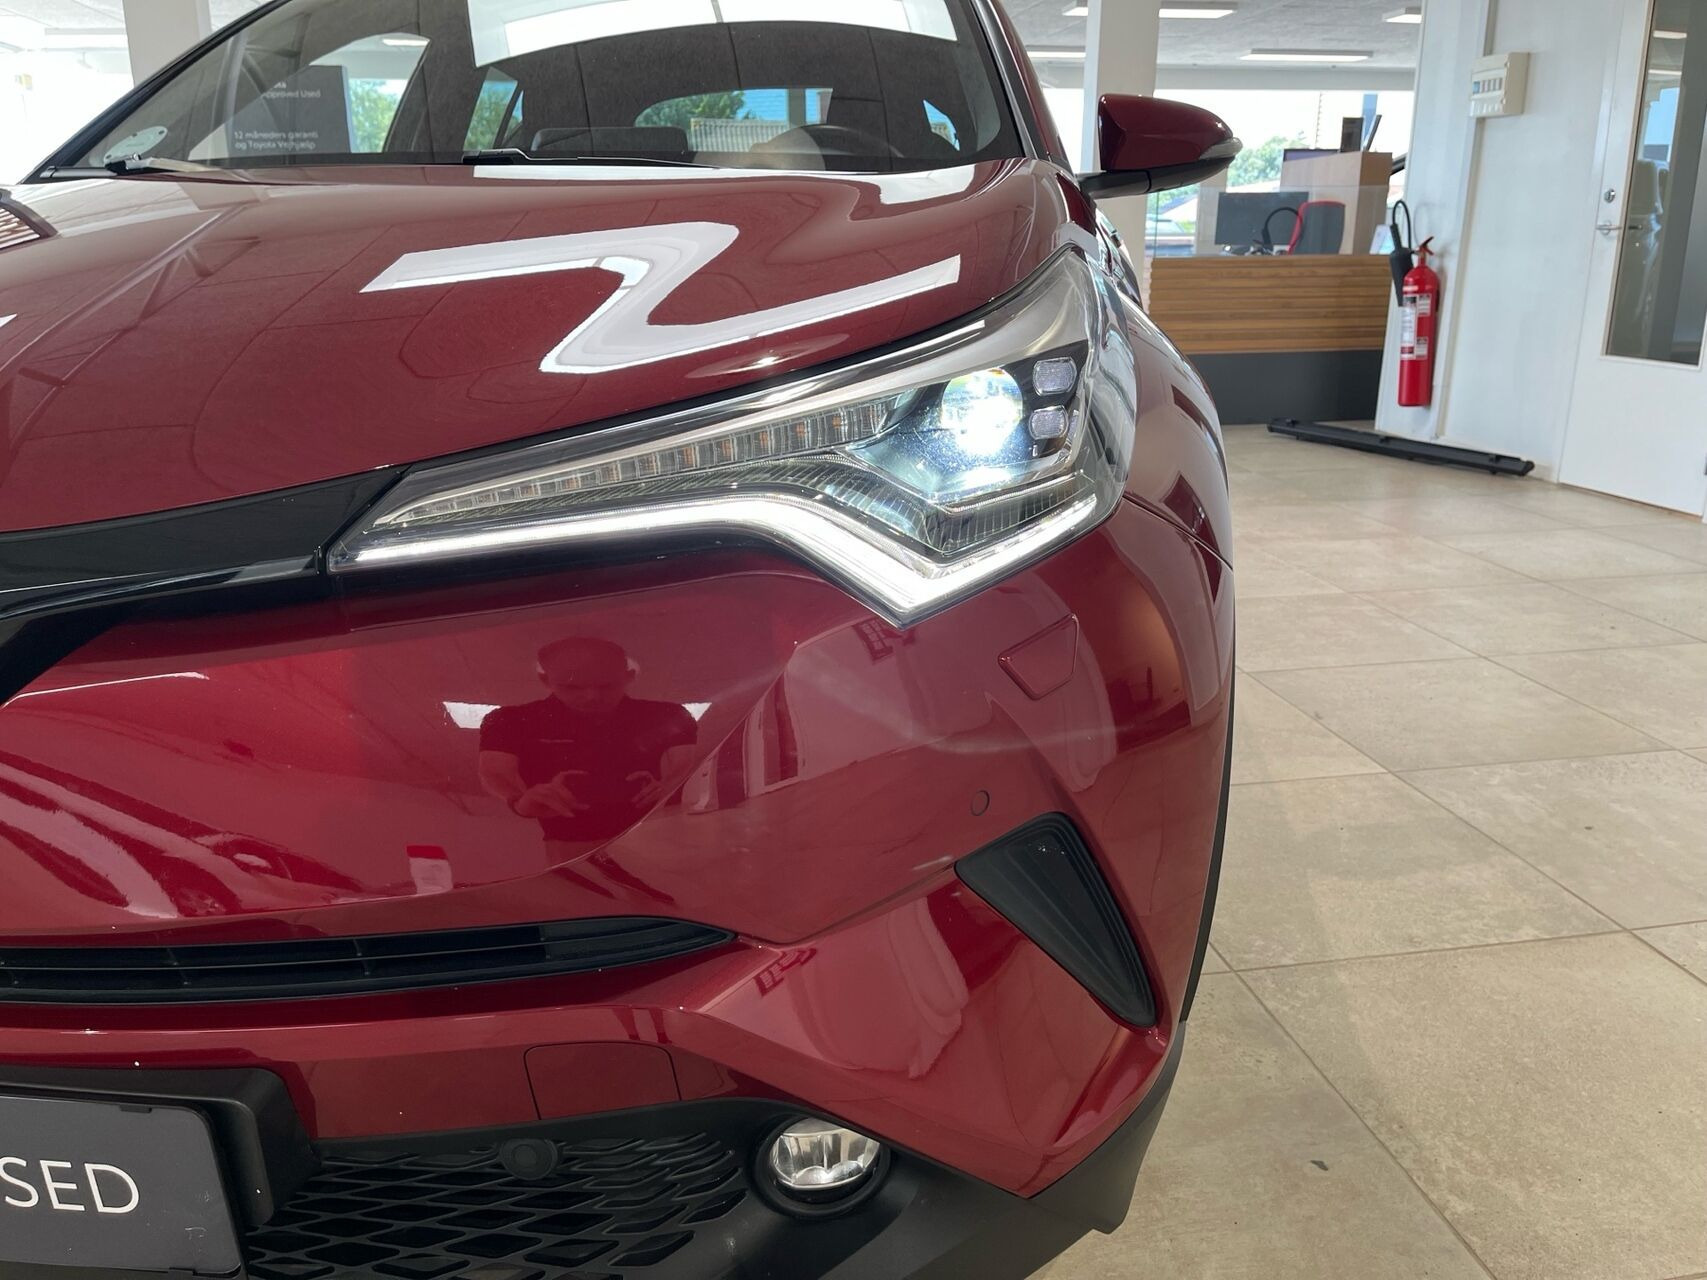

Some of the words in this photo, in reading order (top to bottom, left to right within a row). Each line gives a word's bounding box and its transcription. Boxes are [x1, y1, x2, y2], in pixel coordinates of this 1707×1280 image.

[301, 89, 321, 98] Used
[235, 142, 247, 150] og
[249, 140, 276, 151] Toyota
